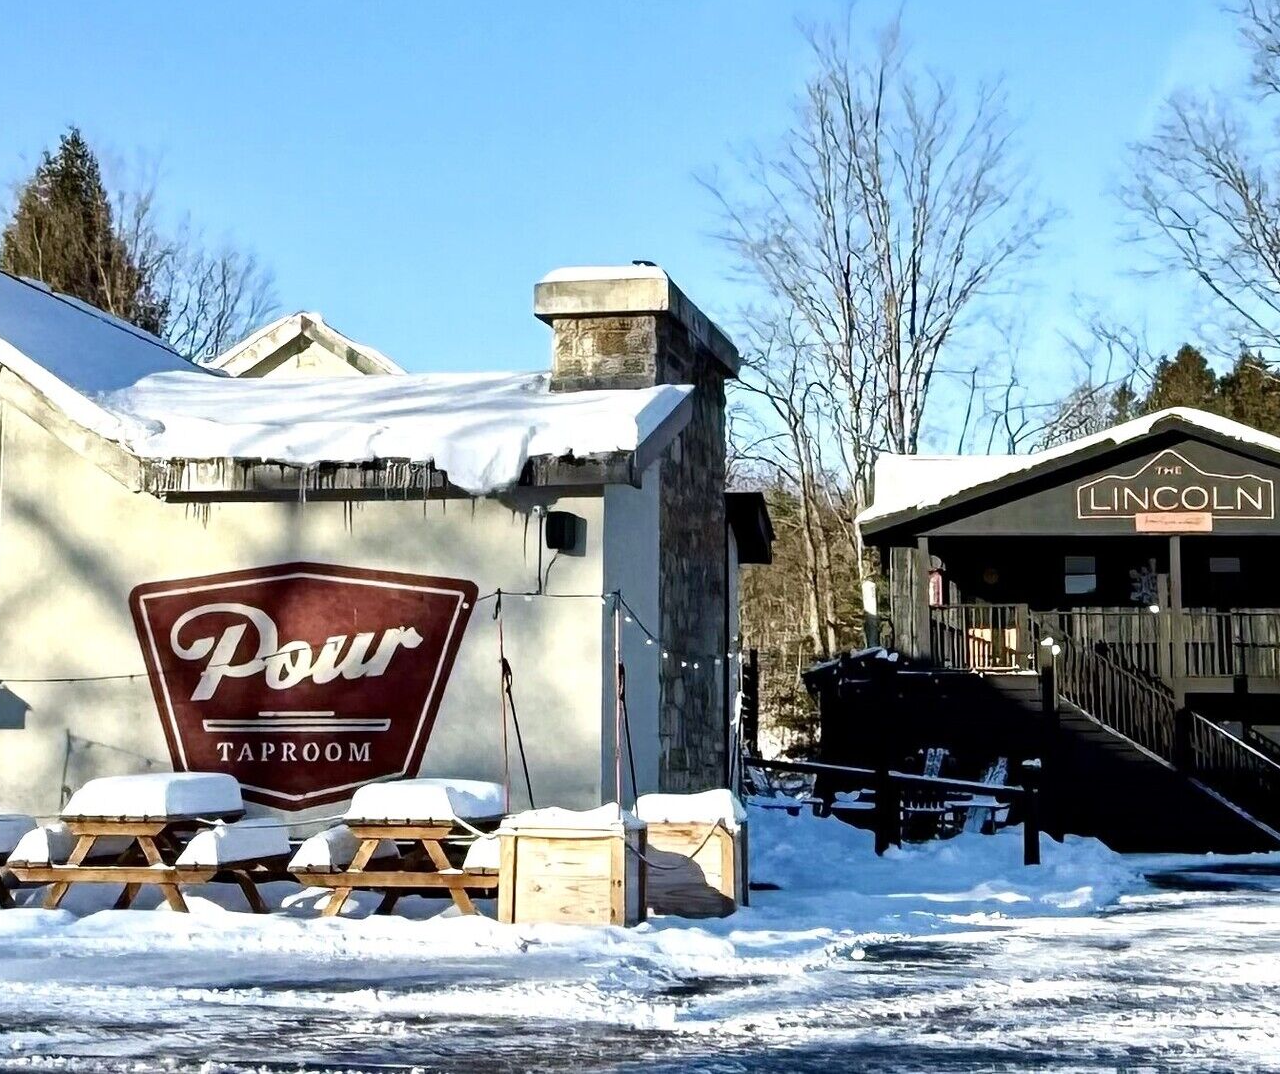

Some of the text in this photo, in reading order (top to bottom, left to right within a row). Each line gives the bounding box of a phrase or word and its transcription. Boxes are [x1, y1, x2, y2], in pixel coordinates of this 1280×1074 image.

[1155, 465, 1183, 475] THE
[1090, 486, 1262, 511] LINCOLN
[170, 602, 423, 701] Pour
[216, 741, 373, 762] TAPROOM
